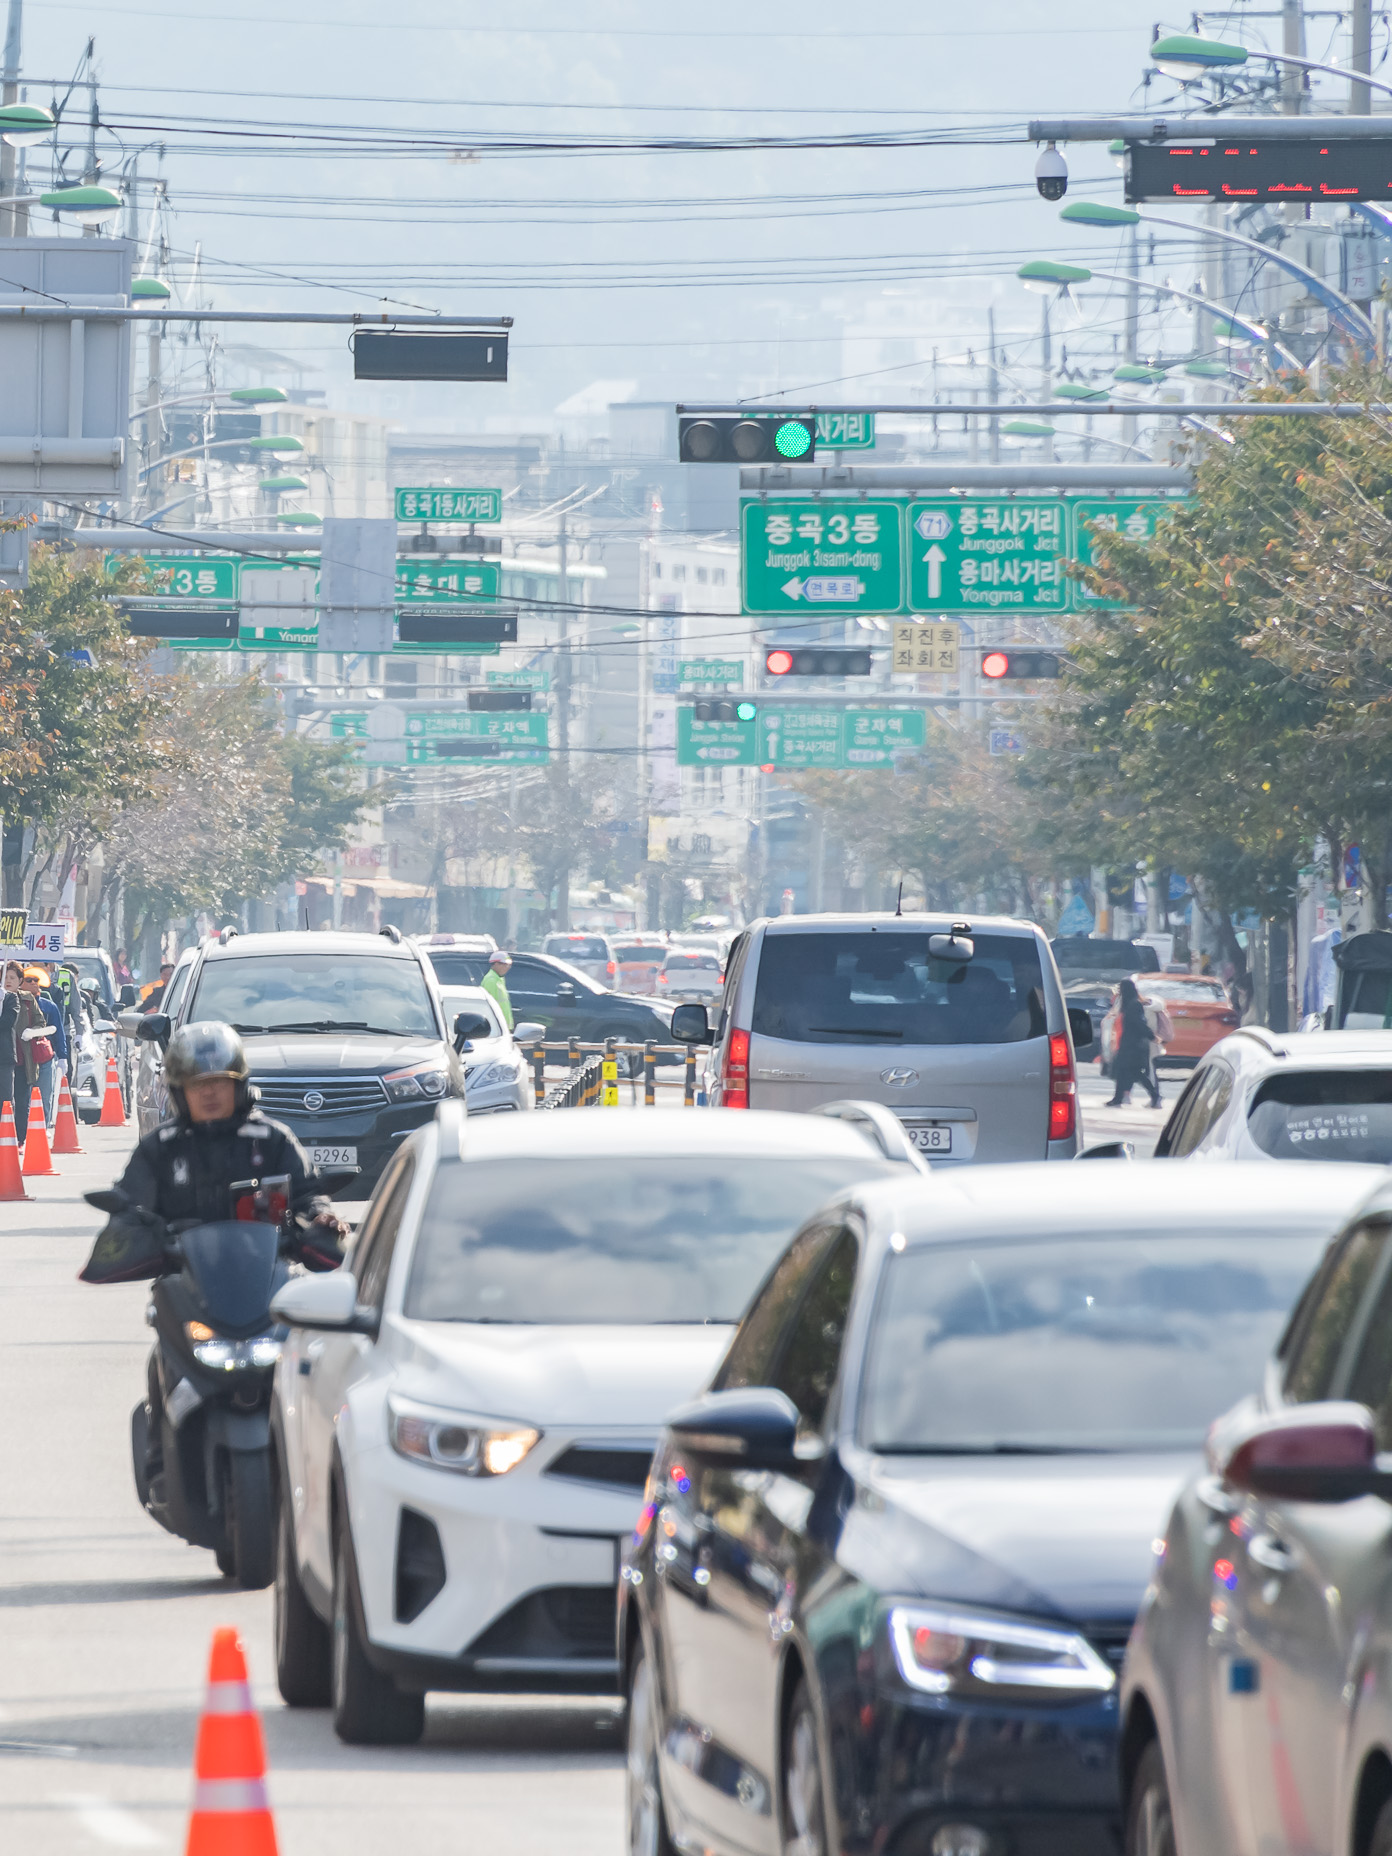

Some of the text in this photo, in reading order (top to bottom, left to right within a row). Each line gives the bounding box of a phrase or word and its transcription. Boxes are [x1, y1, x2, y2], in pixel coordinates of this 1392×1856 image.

[403, 494, 493, 518] 중곡1동사거리
[765, 513, 881, 545] 중곡3동
[922, 518, 943, 534] 71
[959, 507, 1060, 535] 중곡사거리
[959, 537, 1058, 554] Junggok Jct
[765, 550, 810, 571] Junggok
[959, 558, 1060, 585] 용마사거리
[959, 588, 1058, 606] Yongma Jct
[854, 717, 904, 733] 군자역
[313, 1148, 349, 1163] 5296
